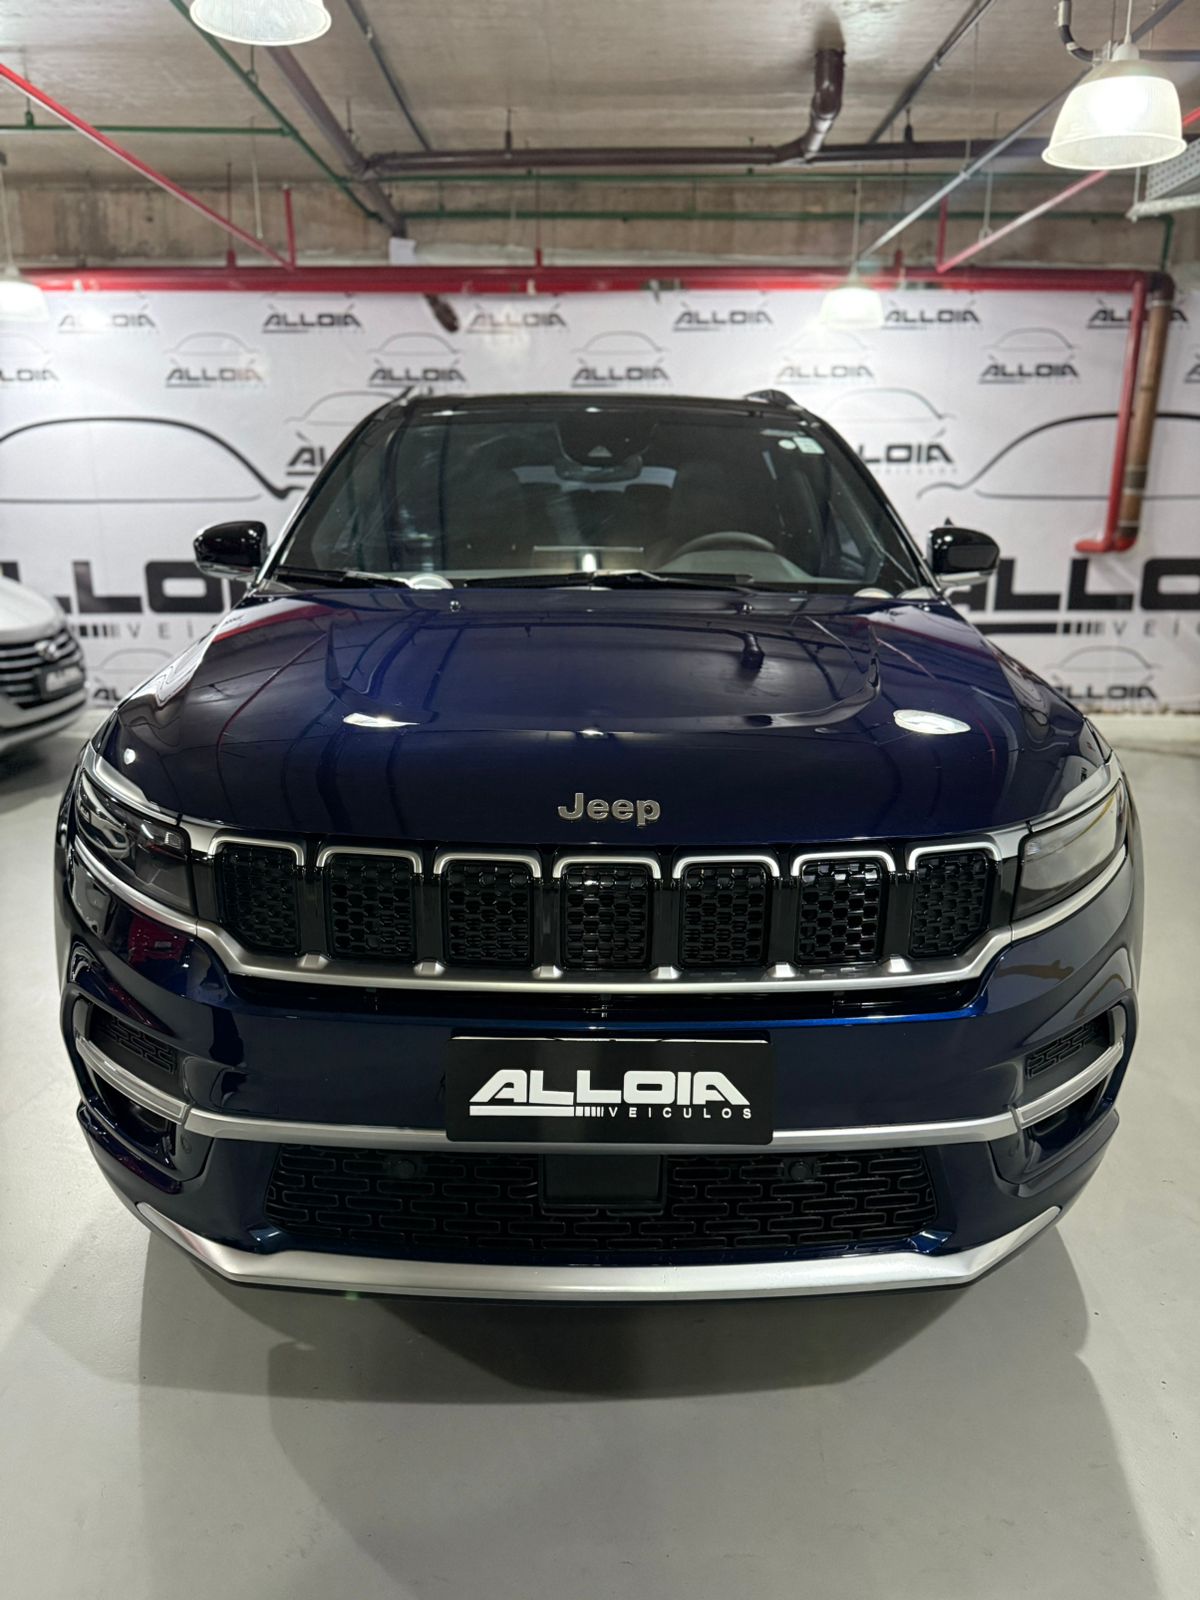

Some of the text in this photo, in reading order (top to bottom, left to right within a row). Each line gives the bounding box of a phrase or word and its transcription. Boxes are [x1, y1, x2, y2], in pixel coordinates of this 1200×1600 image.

[262, 312, 363, 327] ALLOIA
[368, 367, 467, 382] ALLOIA
[571, 366, 670, 381] ALLOIA
[980, 363, 1080, 378] ALLOIA
[557, 792, 661, 827] Jeep
[469, 1069, 751, 1106] ALLOIA
[608, 1106, 752, 1119] VEICULOS
